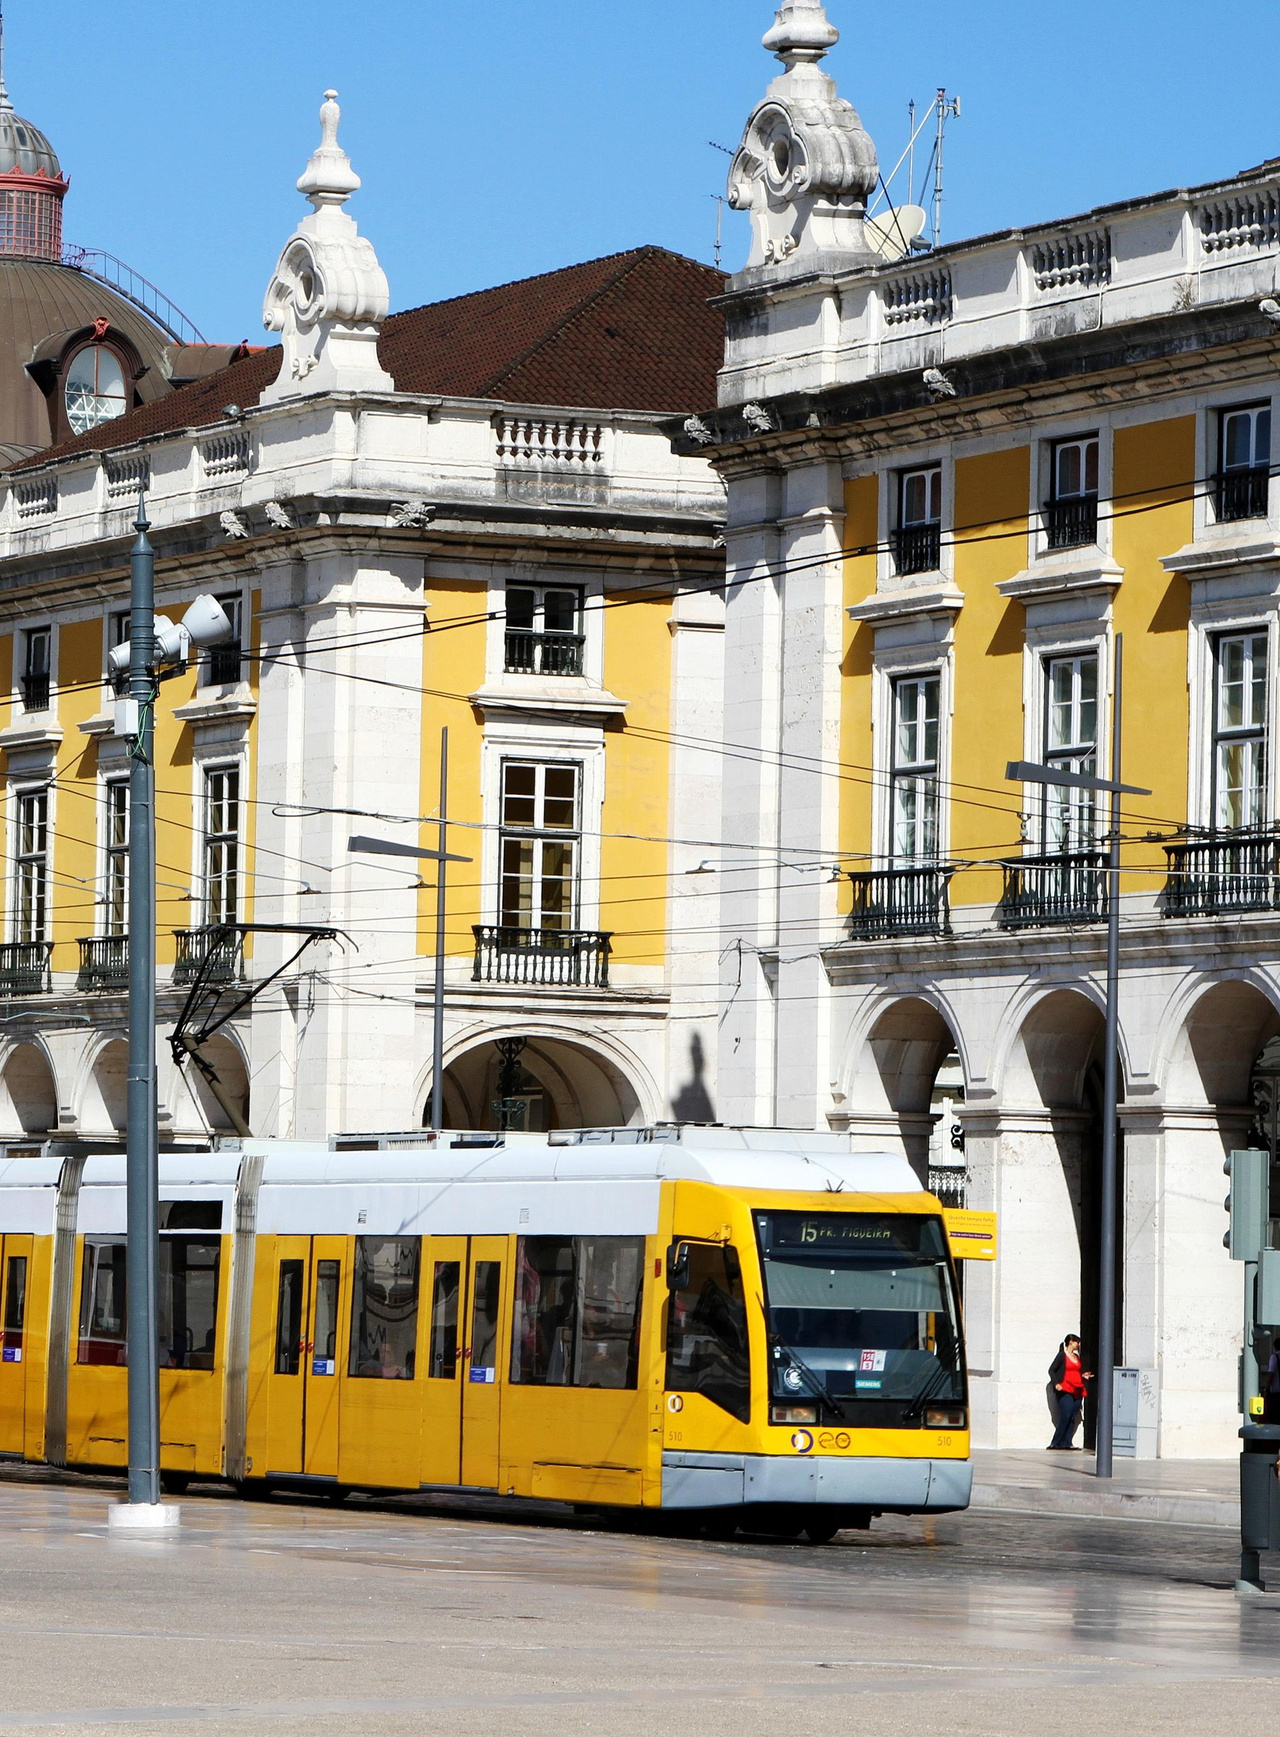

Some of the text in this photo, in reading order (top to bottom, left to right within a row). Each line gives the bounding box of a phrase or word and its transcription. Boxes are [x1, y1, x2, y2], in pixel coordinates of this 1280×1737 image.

[842, 1226, 891, 1239] FIGUEIRA
[669, 1430, 683, 1442] 510
[937, 1435, 952, 1447] 510
